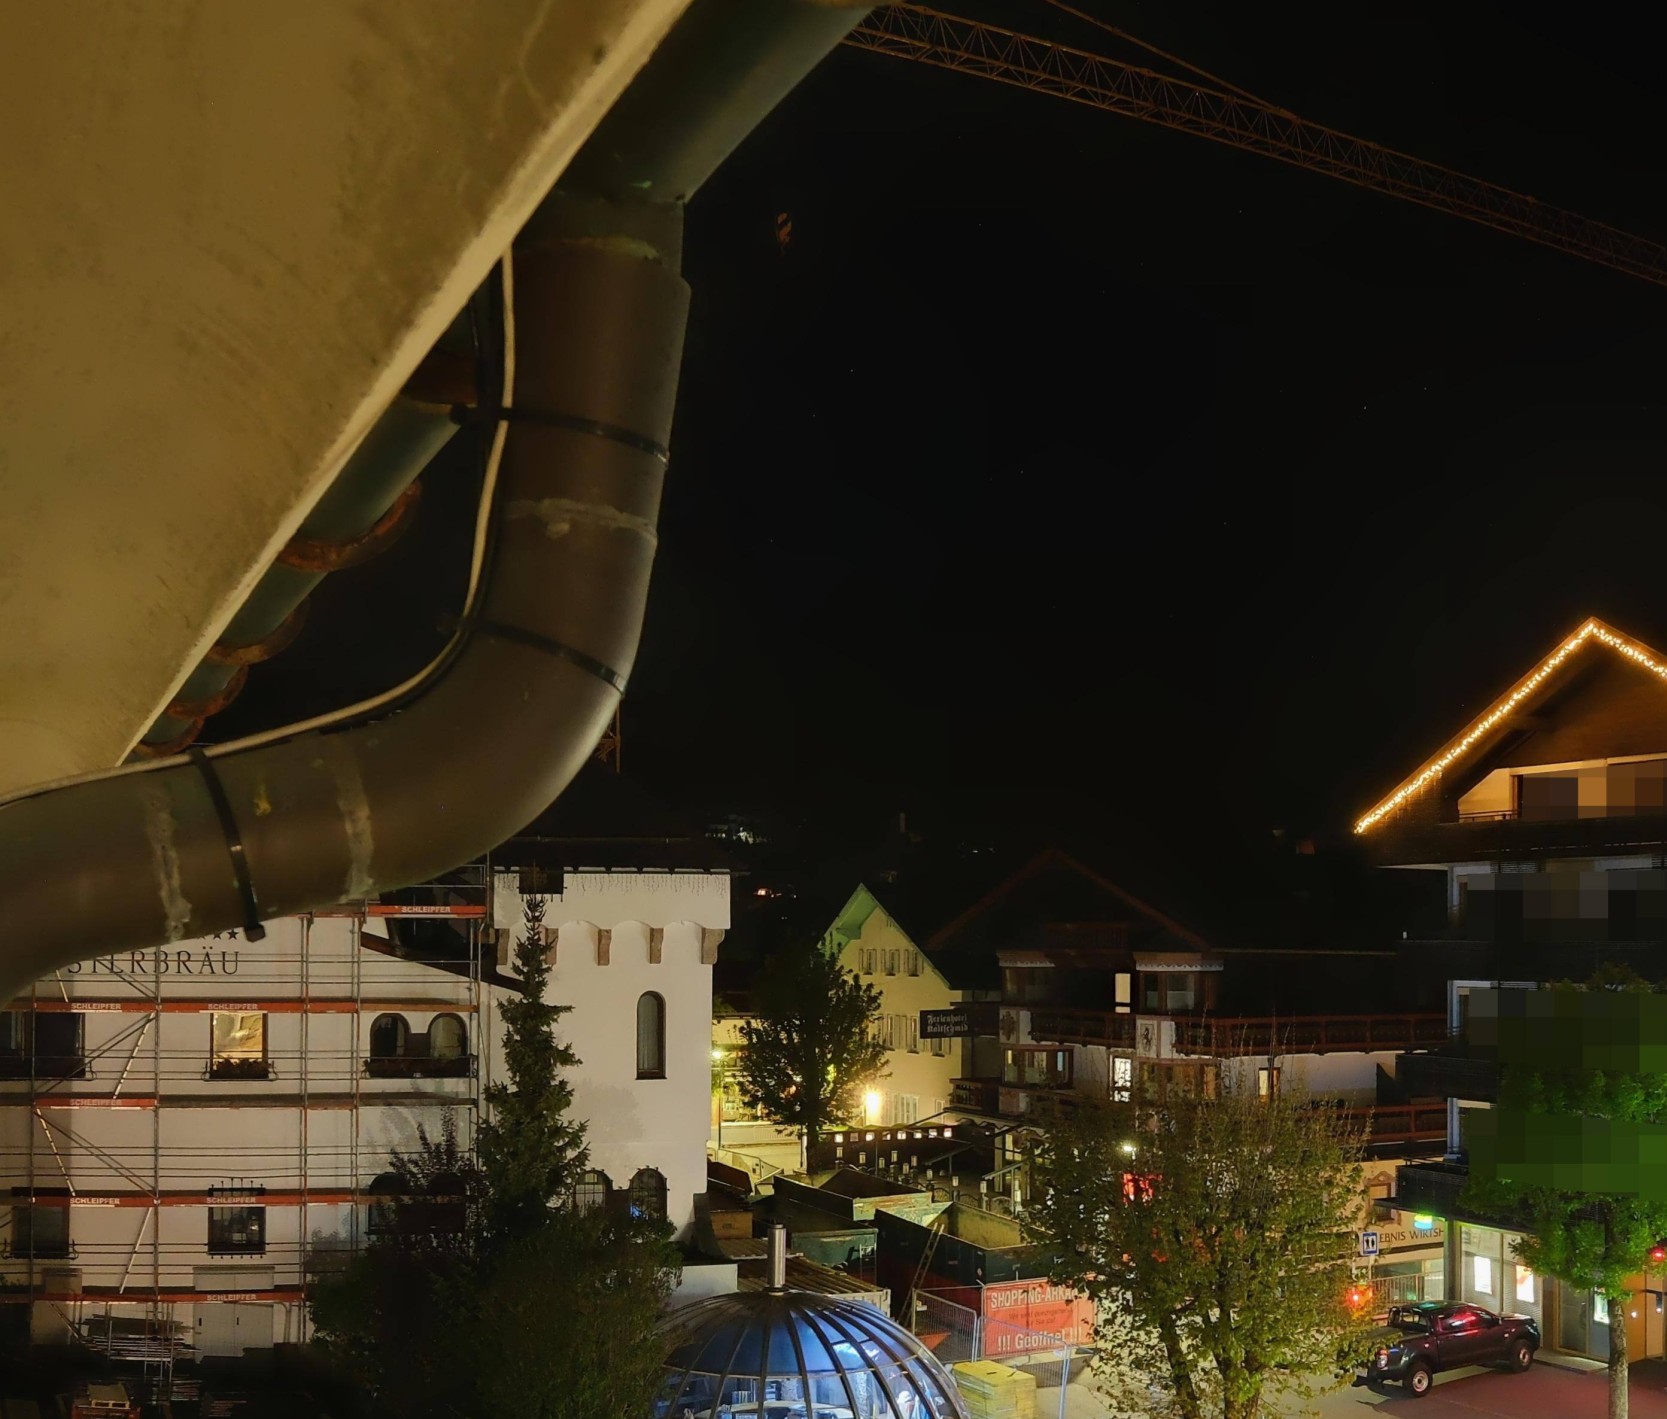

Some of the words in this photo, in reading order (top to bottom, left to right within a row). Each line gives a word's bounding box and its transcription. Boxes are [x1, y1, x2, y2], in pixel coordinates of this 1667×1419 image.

[67, 945, 240, 975] STERBRÄU
[71, 1002, 122, 1010] SCHLEIPFER
[70, 1197, 120, 1205] SCHLEIPFER
[1379, 1231, 1406, 1243] EBNIS
[1409, 1227, 1444, 1240] WIRTSH
